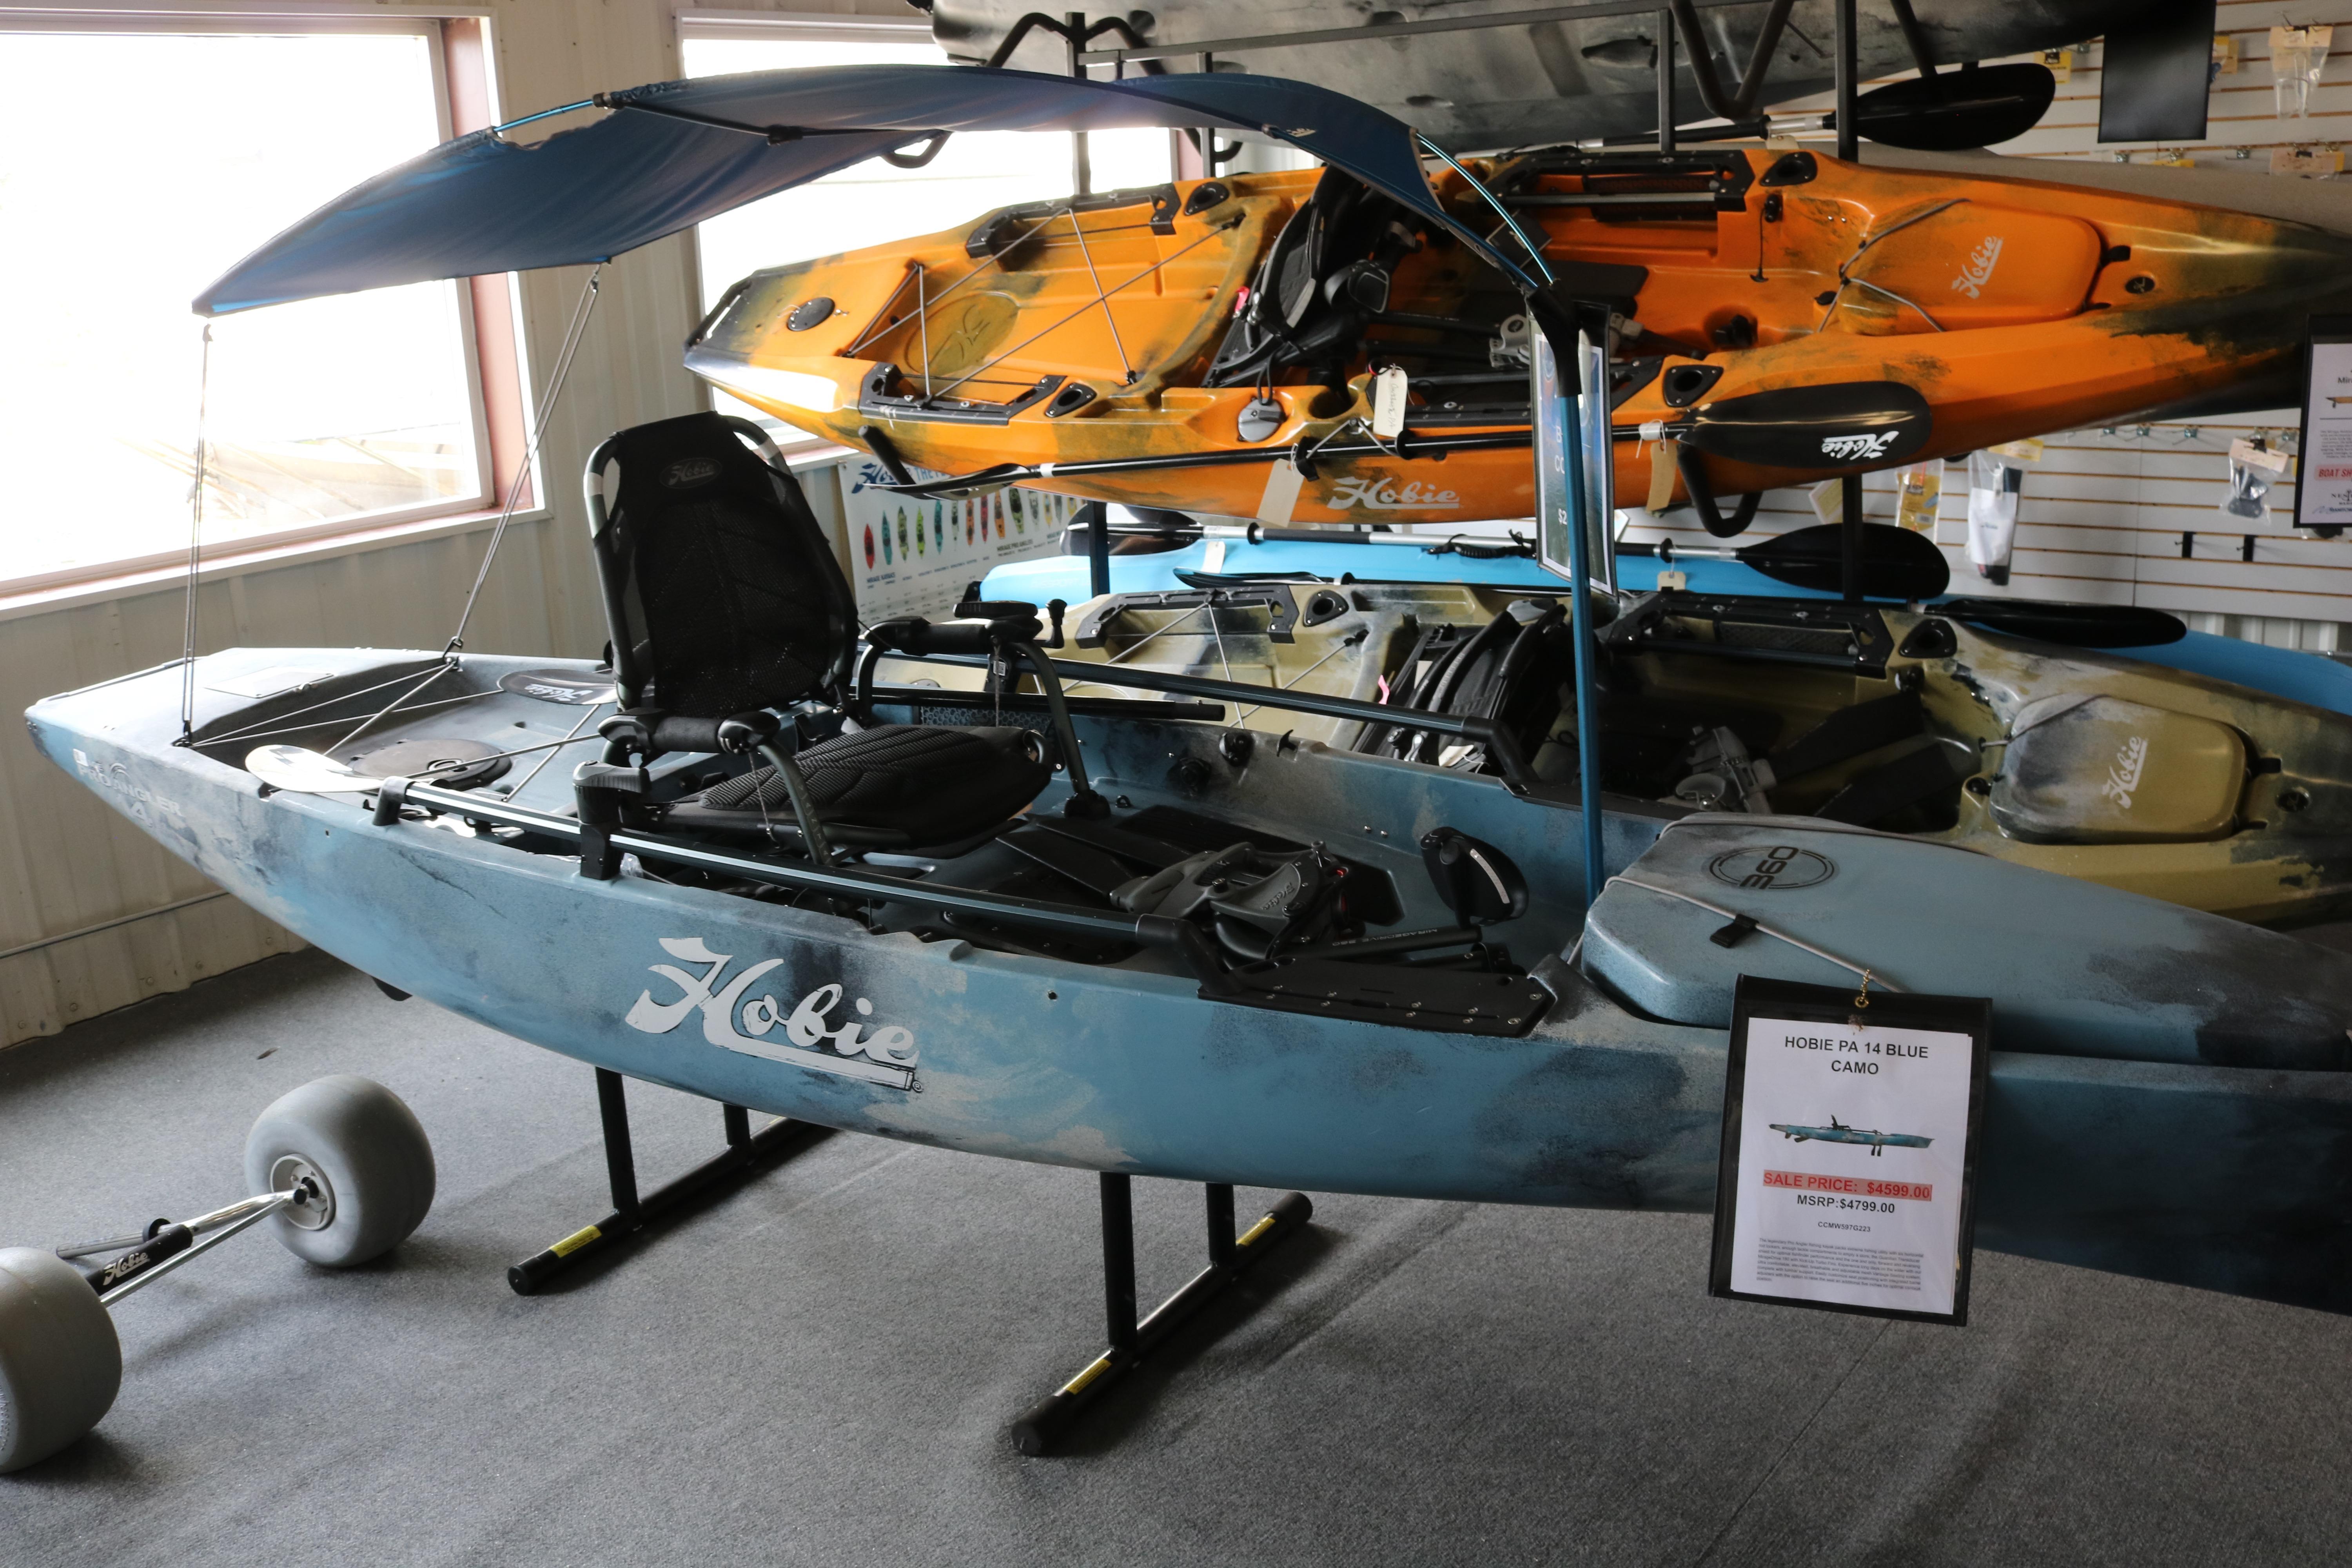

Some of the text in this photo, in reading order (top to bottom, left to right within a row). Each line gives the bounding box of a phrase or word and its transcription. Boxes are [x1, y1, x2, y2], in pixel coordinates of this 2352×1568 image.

[1952, 235, 2004, 299] Hobie
[1822, 431, 1899, 459] Hobie
[668, 461, 715, 486] Hobie
[1327, 477, 1460, 509] Hobie
[524, 683, 593, 701] Hobie
[2102, 736, 2149, 809] Hobie
[1739, 846, 1799, 889] 360
[1361, 928, 1437, 942] MIRAGEDRIVE
[625, 937, 920, 1091] Hobie
[1785, 1036, 1929, 1059] HOBIE PA 14 BLUE
[1831, 1060, 1879, 1075] CAMO
[1763, 1172, 1930, 1200] SALE PRICE: $4599.00
[1797, 1194, 1895, 1214] MSRP:$4799.00
[103, 1252, 151, 1285] Hobie
